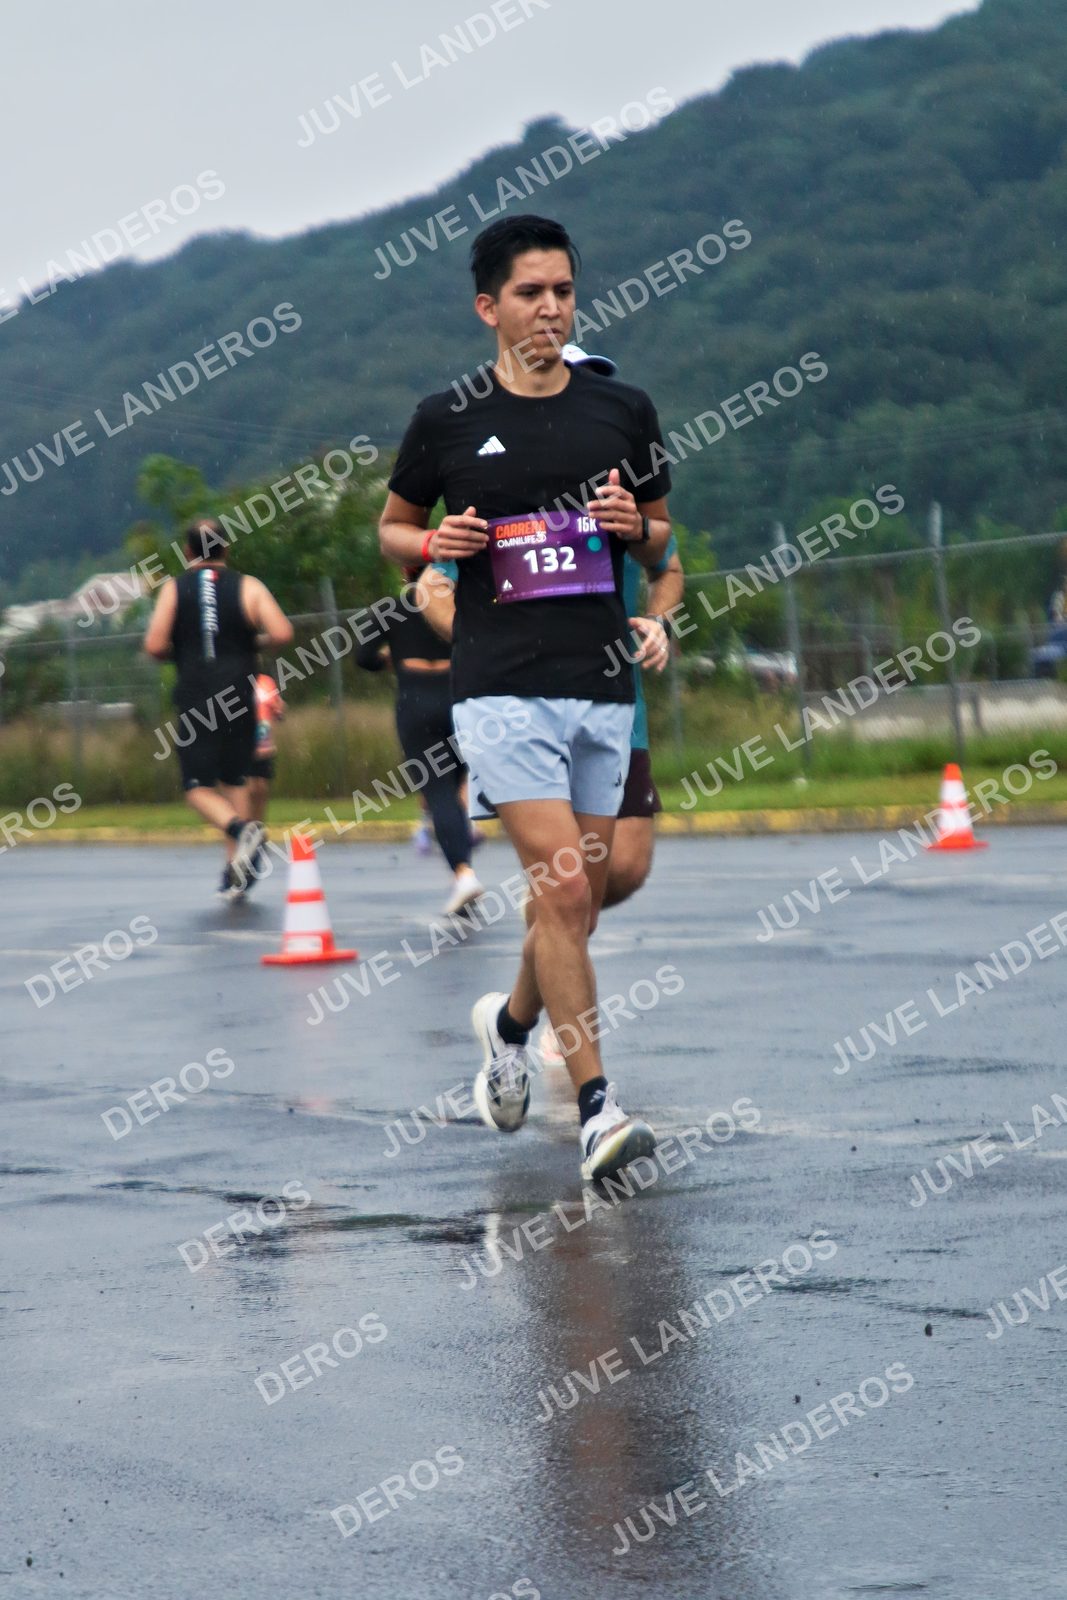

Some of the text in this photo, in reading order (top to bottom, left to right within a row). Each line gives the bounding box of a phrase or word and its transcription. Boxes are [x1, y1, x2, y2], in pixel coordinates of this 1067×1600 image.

[496, 519, 546, 539] CARRERA
[497, 534, 536, 548] OMNILIFE
[523, 546, 577, 574] 132
